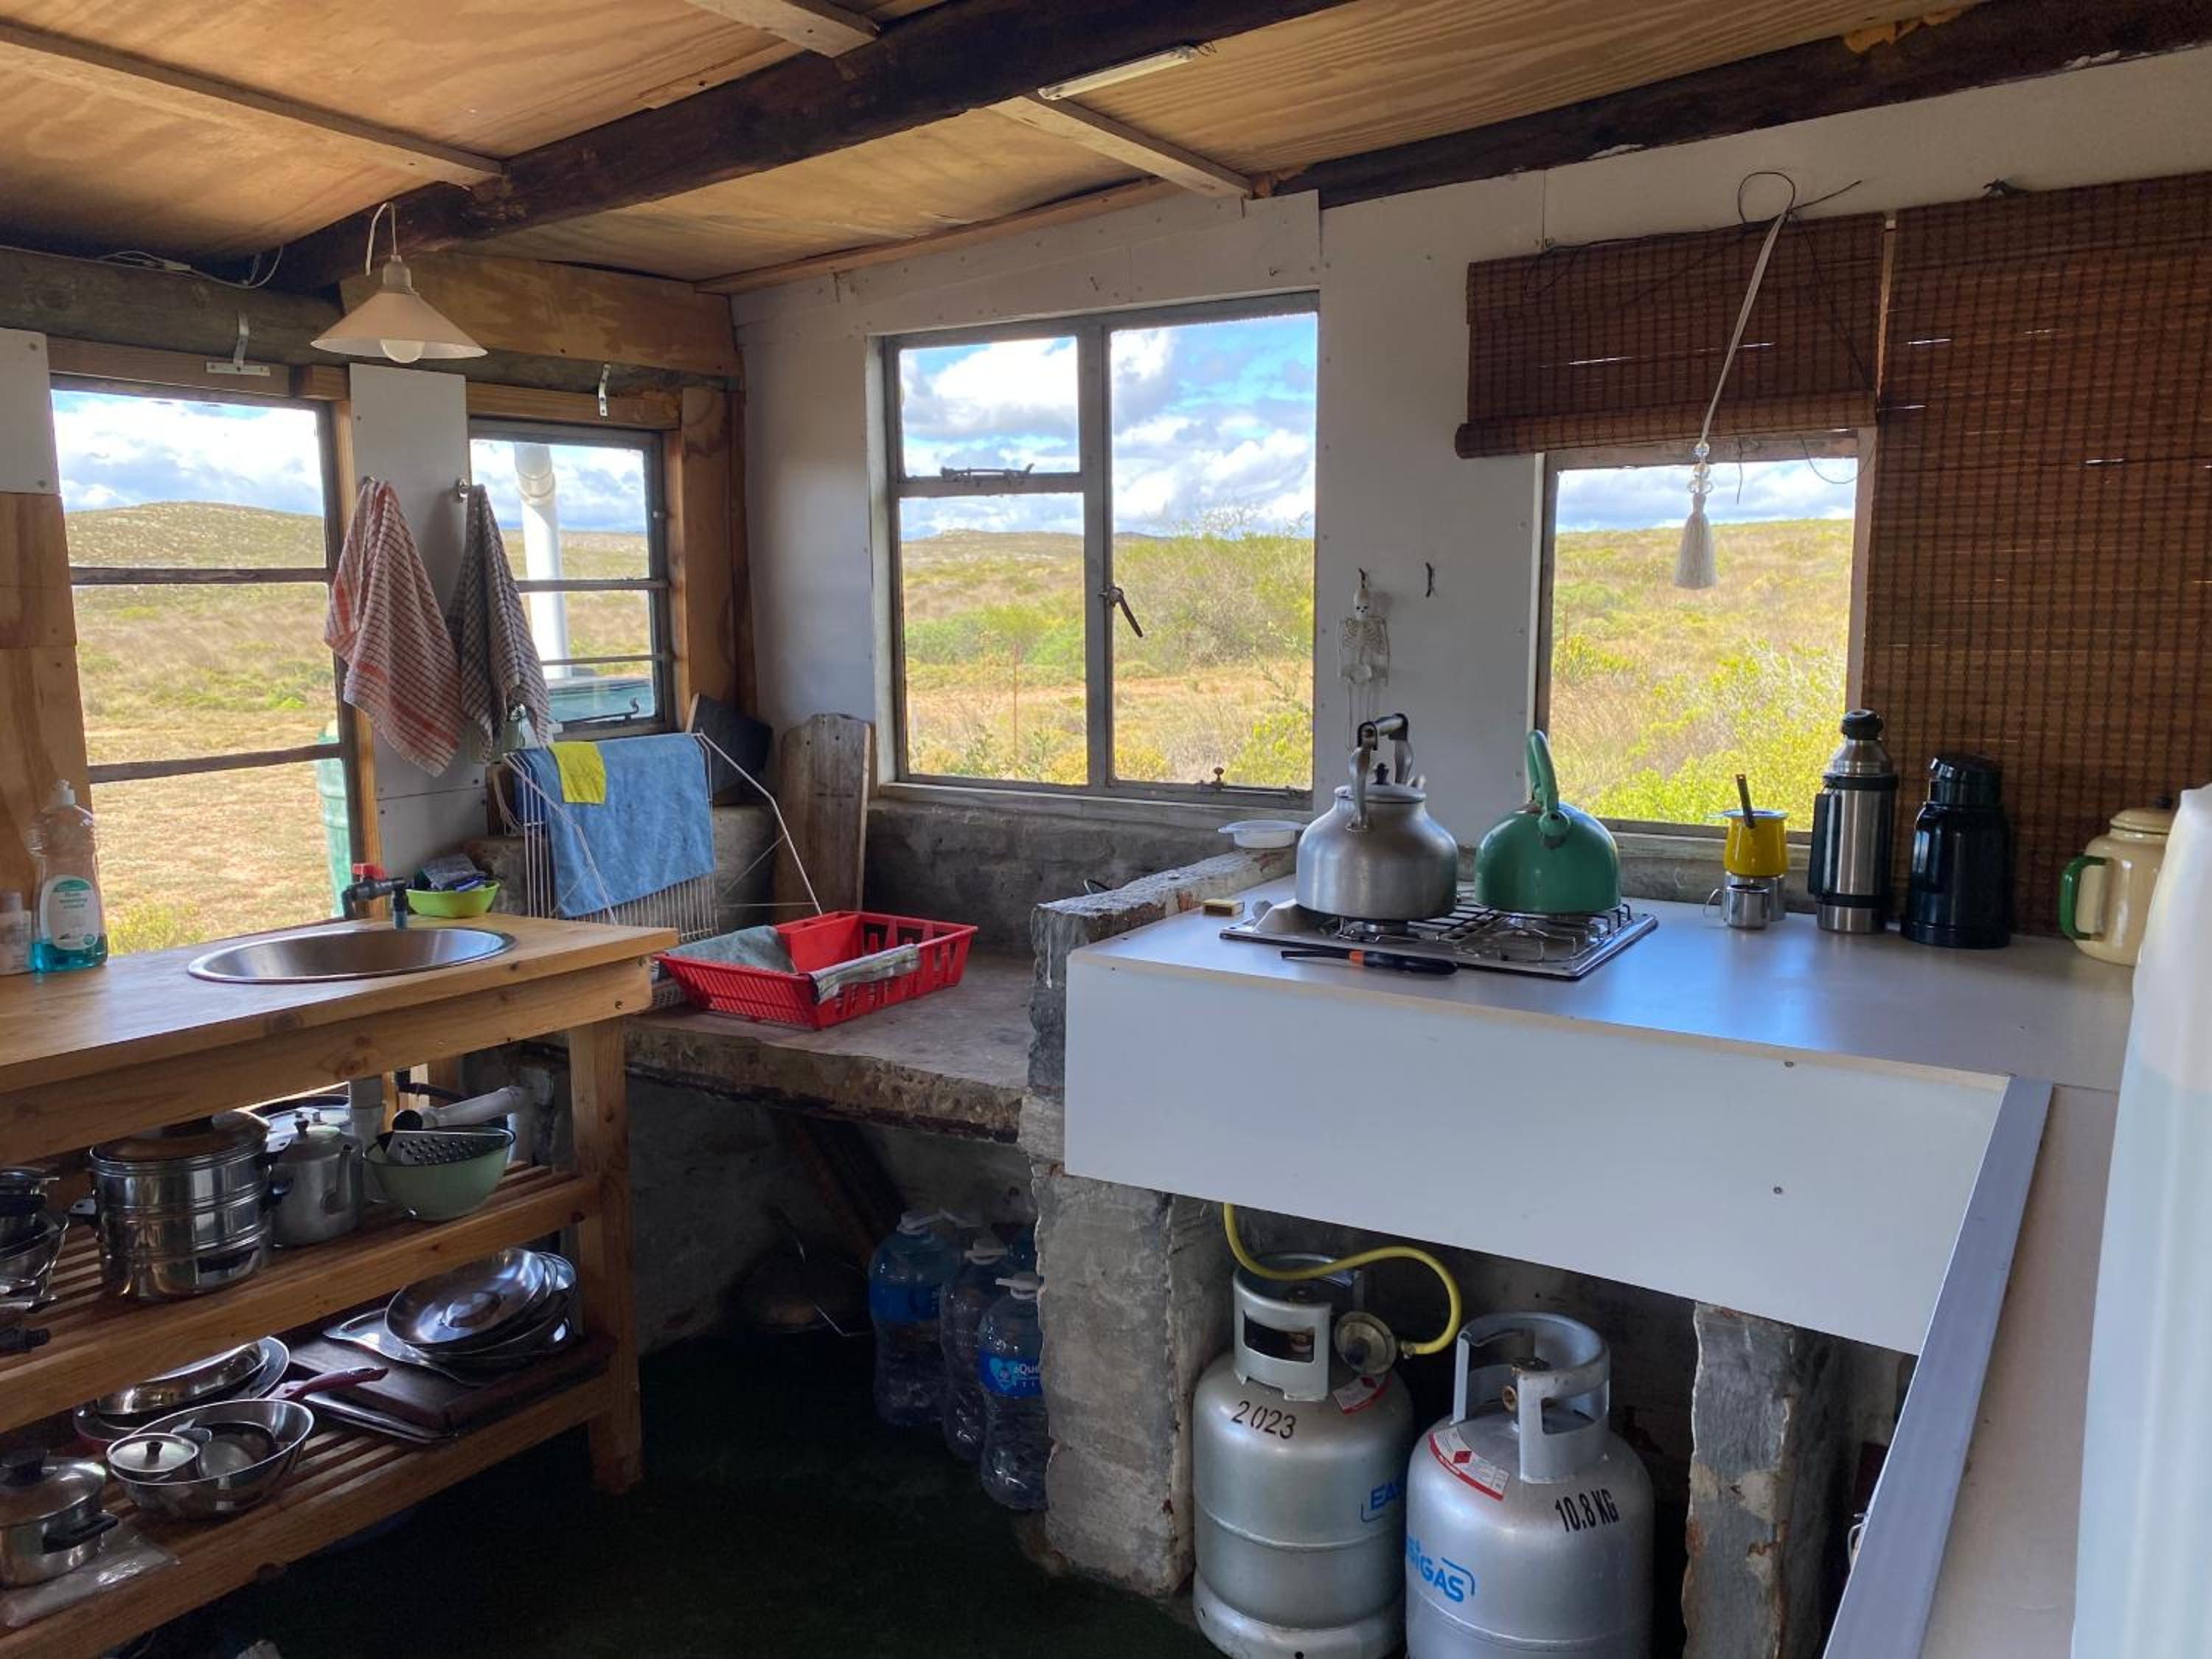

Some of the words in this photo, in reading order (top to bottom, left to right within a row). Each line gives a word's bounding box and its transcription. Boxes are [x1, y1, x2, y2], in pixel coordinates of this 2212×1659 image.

[1231, 1400, 1296, 1439] 2023
[1555, 1492, 1596, 1532] 10.8
[1591, 1489, 1620, 1525] KG
